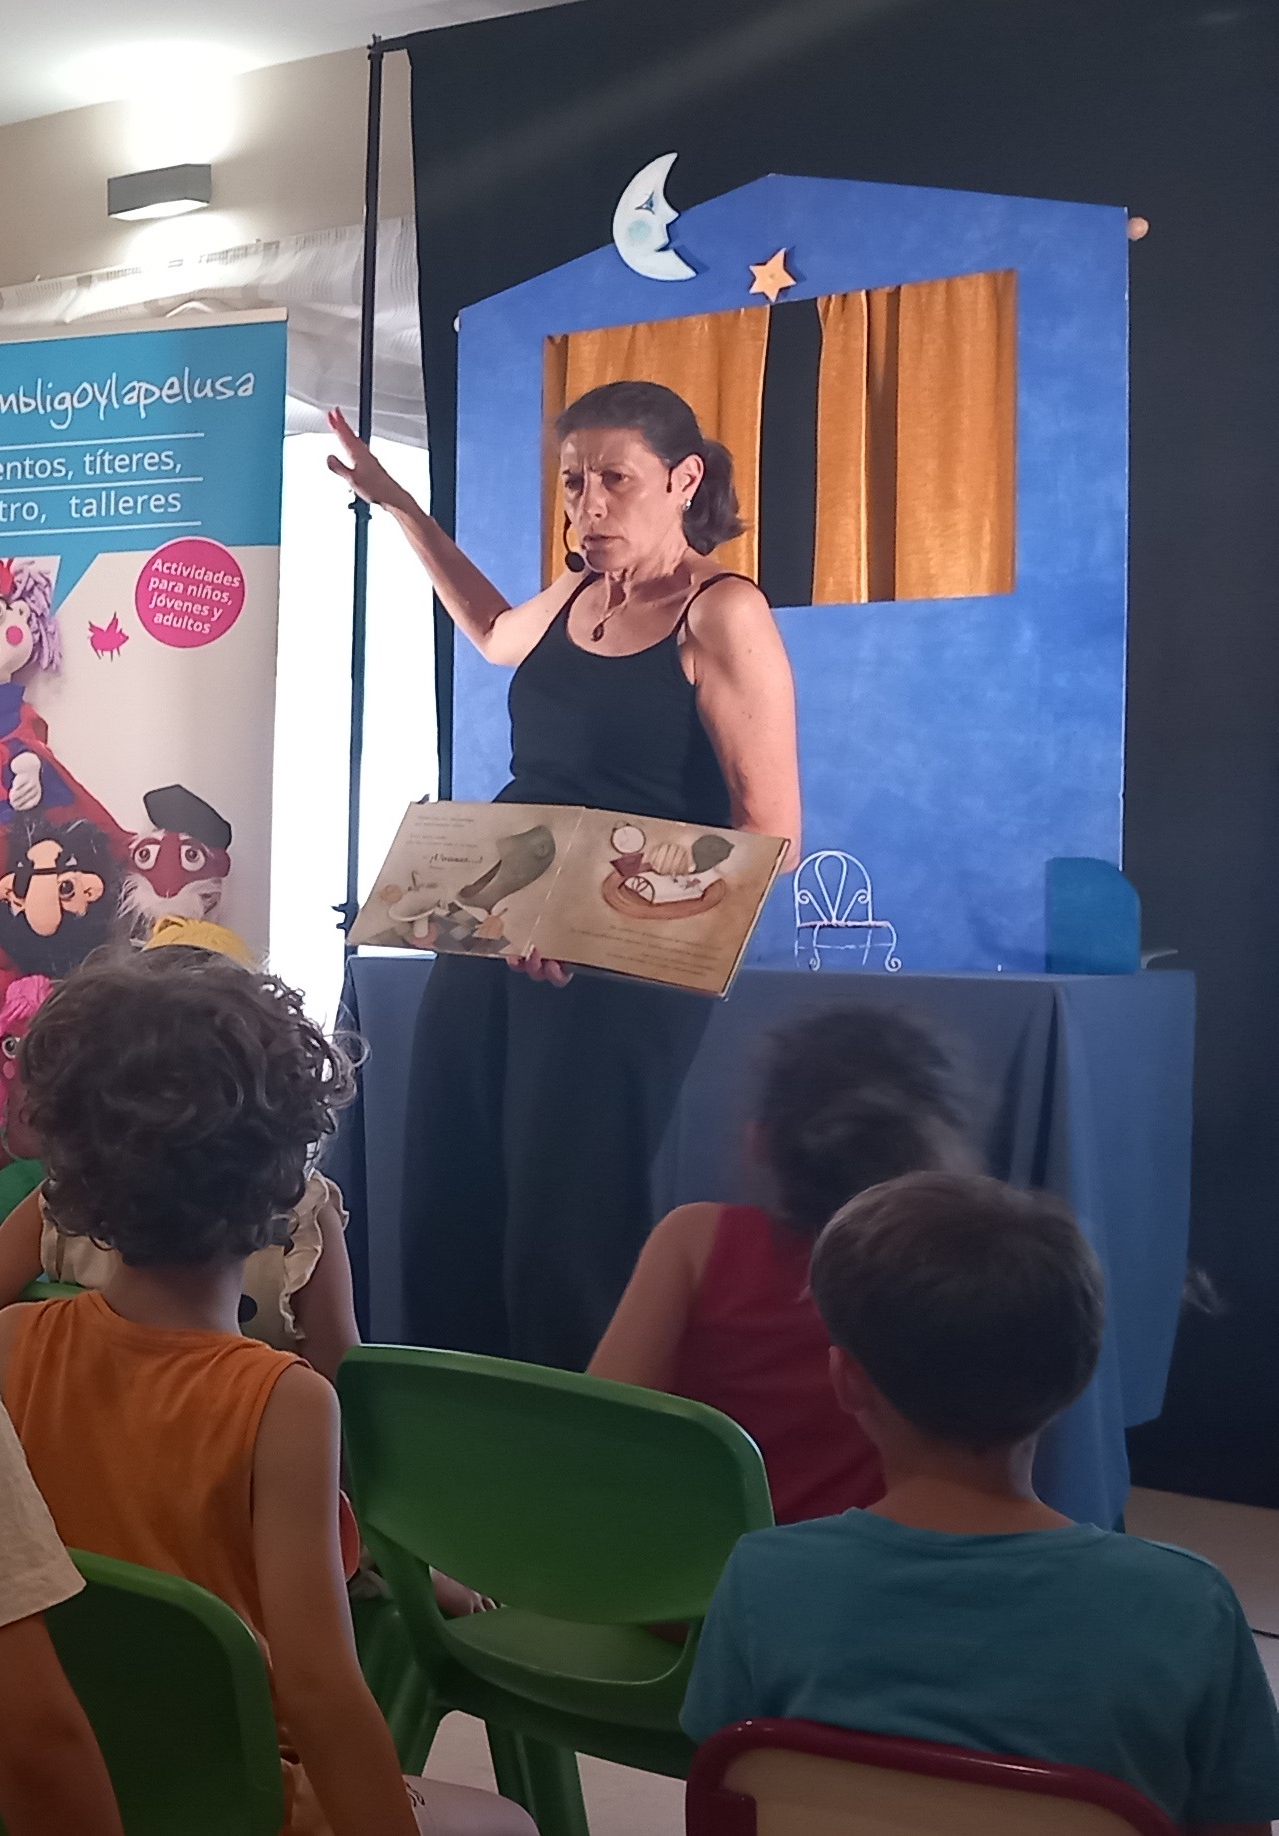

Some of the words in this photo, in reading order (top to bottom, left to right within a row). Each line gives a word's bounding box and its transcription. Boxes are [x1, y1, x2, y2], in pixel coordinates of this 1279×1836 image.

[83, 449, 183, 476] títeres,
[69, 490, 182, 519] talleres
[151, 558, 241, 588] Actividades
[148, 576, 184, 594] para
[187, 583, 233, 606] niños,
[149, 592, 210, 616] jóvenes
[210, 607, 224, 622] y
[153, 612, 212, 634] adultos
